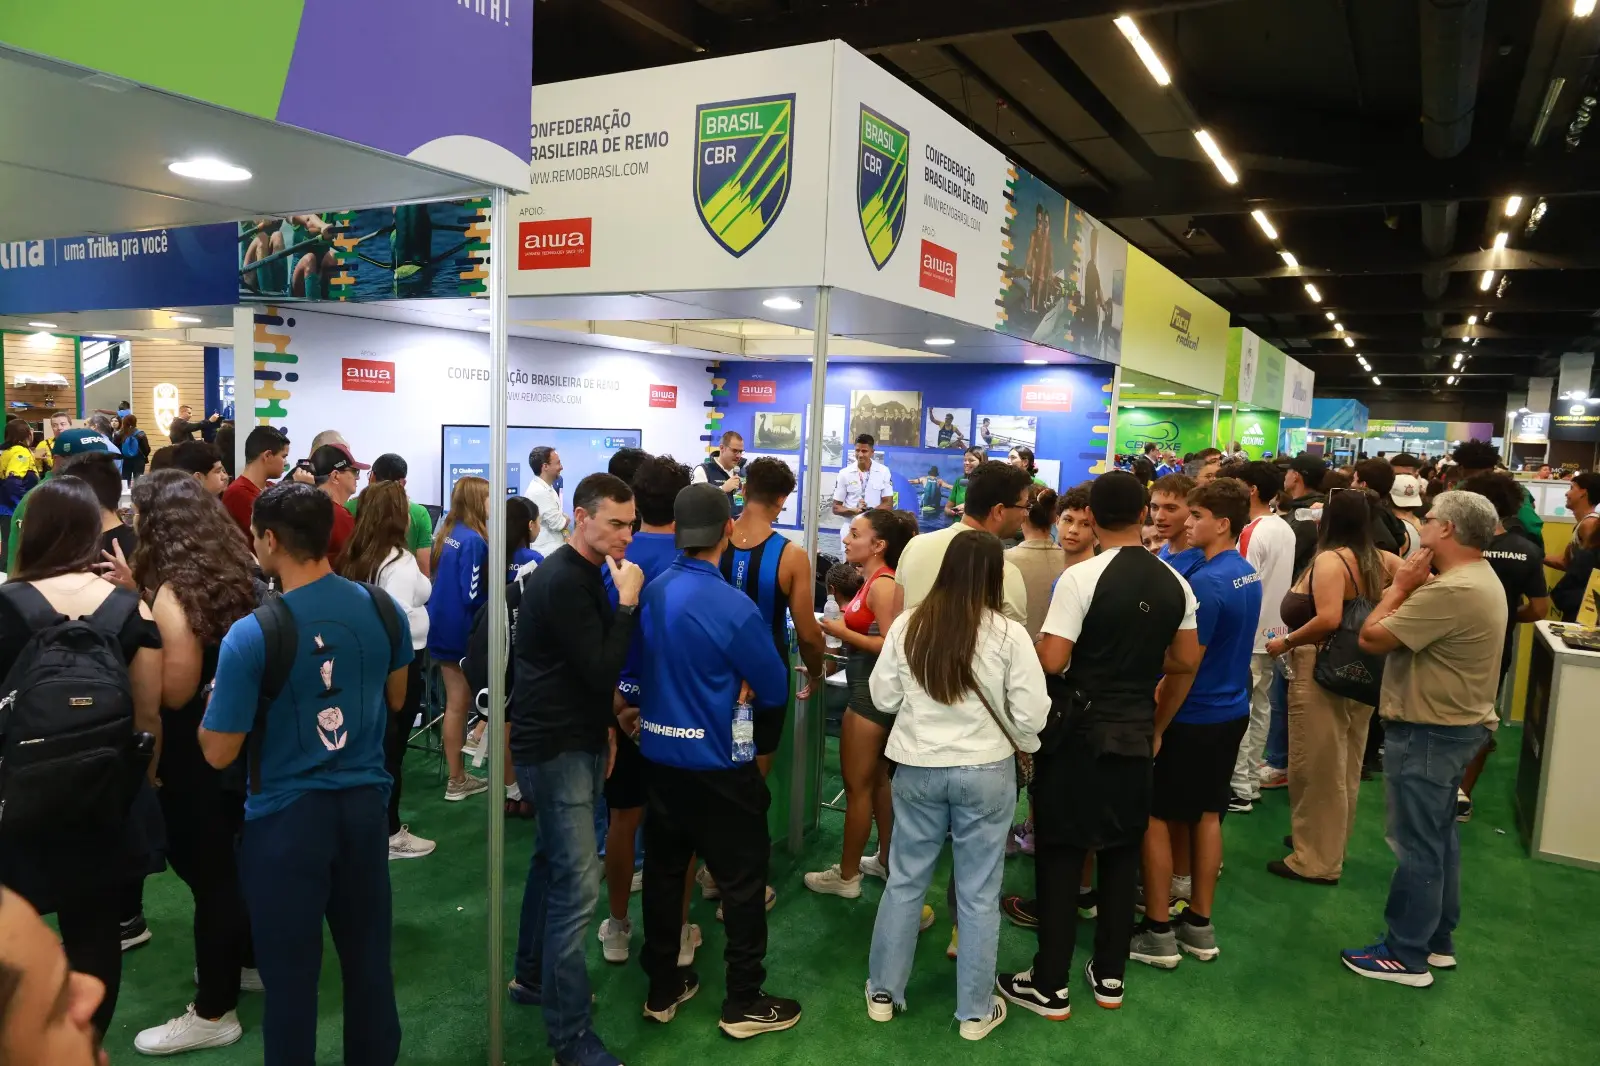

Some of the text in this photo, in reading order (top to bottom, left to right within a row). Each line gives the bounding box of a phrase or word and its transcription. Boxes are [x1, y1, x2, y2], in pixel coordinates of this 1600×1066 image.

[531, 109, 631, 139] ONFEDERAÇÃO
[706, 112, 763, 135] BRASIL
[530, 131, 669, 161] RASILEIRA DE REMO
[865, 120, 895, 153] BRASIL
[704, 145, 737, 165] CBR
[864, 152, 882, 176] CBR
[530, 161, 649, 185] WW.REMOBRASIL.COM
[925, 144, 975, 187] CONFEDERAÇÃO
[924, 166, 988, 214] BRASILEIRA DE REMO
[64, 243, 85, 261] uma
[87, 237, 119, 259] Trilha
[121, 238, 139, 261] pra
[142, 229, 168, 253] você
[524, 232, 584, 249] aiwa
[923, 254, 953, 277] aiwa
[346, 367, 391, 379] aiwa
[531, 373, 582, 388] BRASILEIRA
[583, 378, 595, 389] DE
[651, 390, 675, 399] aiwa
[742, 386, 773, 394] aiwa
[1522, 417, 1543, 428] SUN
[80, 436, 105, 445] BRA
[1125, 440, 1182, 451] CBOXE
[1241, 436, 1265, 446] BOXING
[1482, 550, 1528, 561] INTHIANS
[736, 560, 745, 590] EIROS
[643, 722, 705, 739] PINHEIROS
